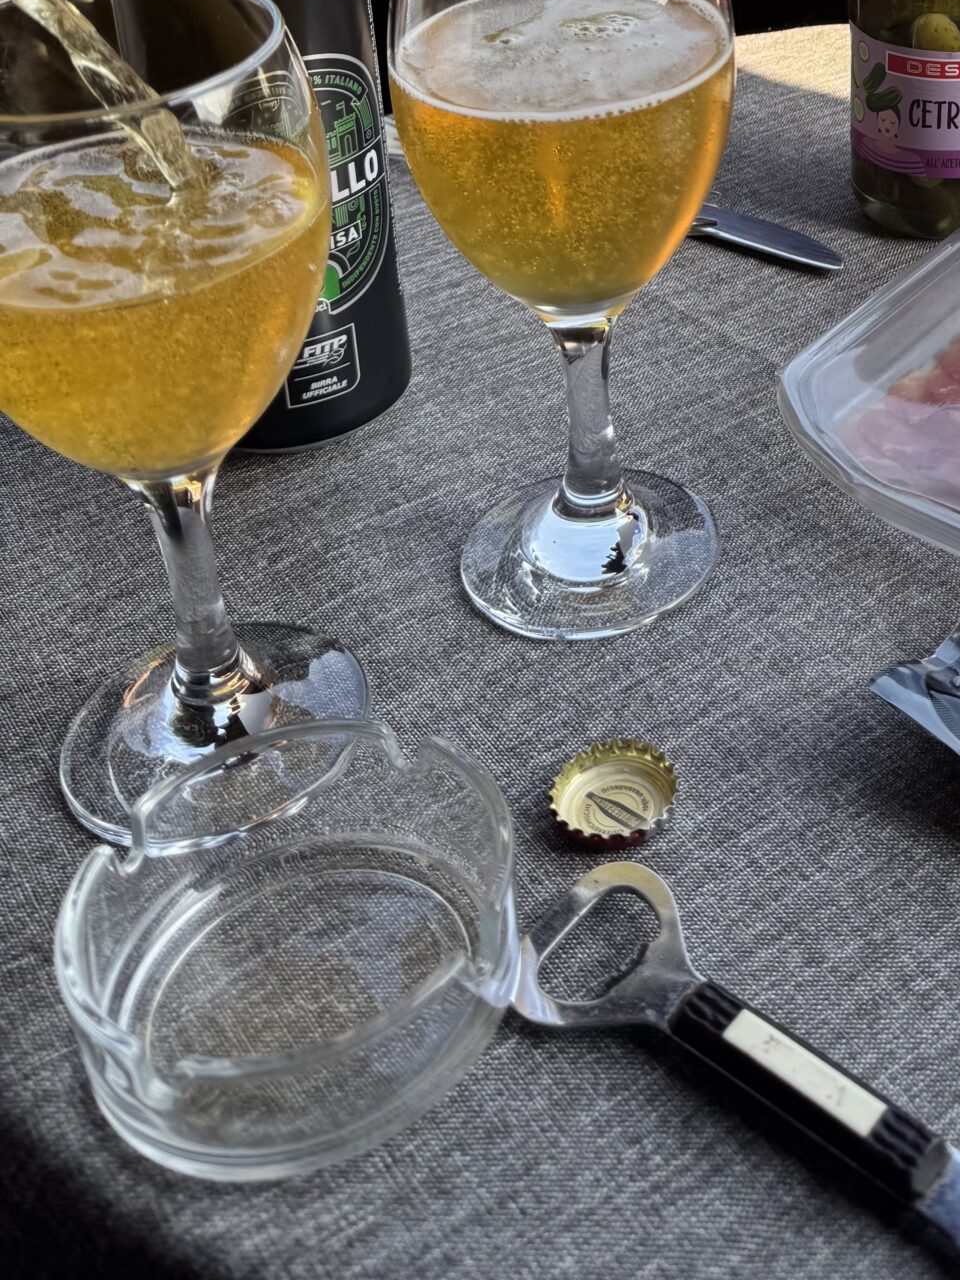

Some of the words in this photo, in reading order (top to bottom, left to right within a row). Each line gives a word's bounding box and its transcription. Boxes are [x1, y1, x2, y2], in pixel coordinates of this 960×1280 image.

[325, 74, 363, 95] ITALIANO
[302, 379, 348, 399] UFFICIALE
[310, 375, 338, 390] BIRRA
